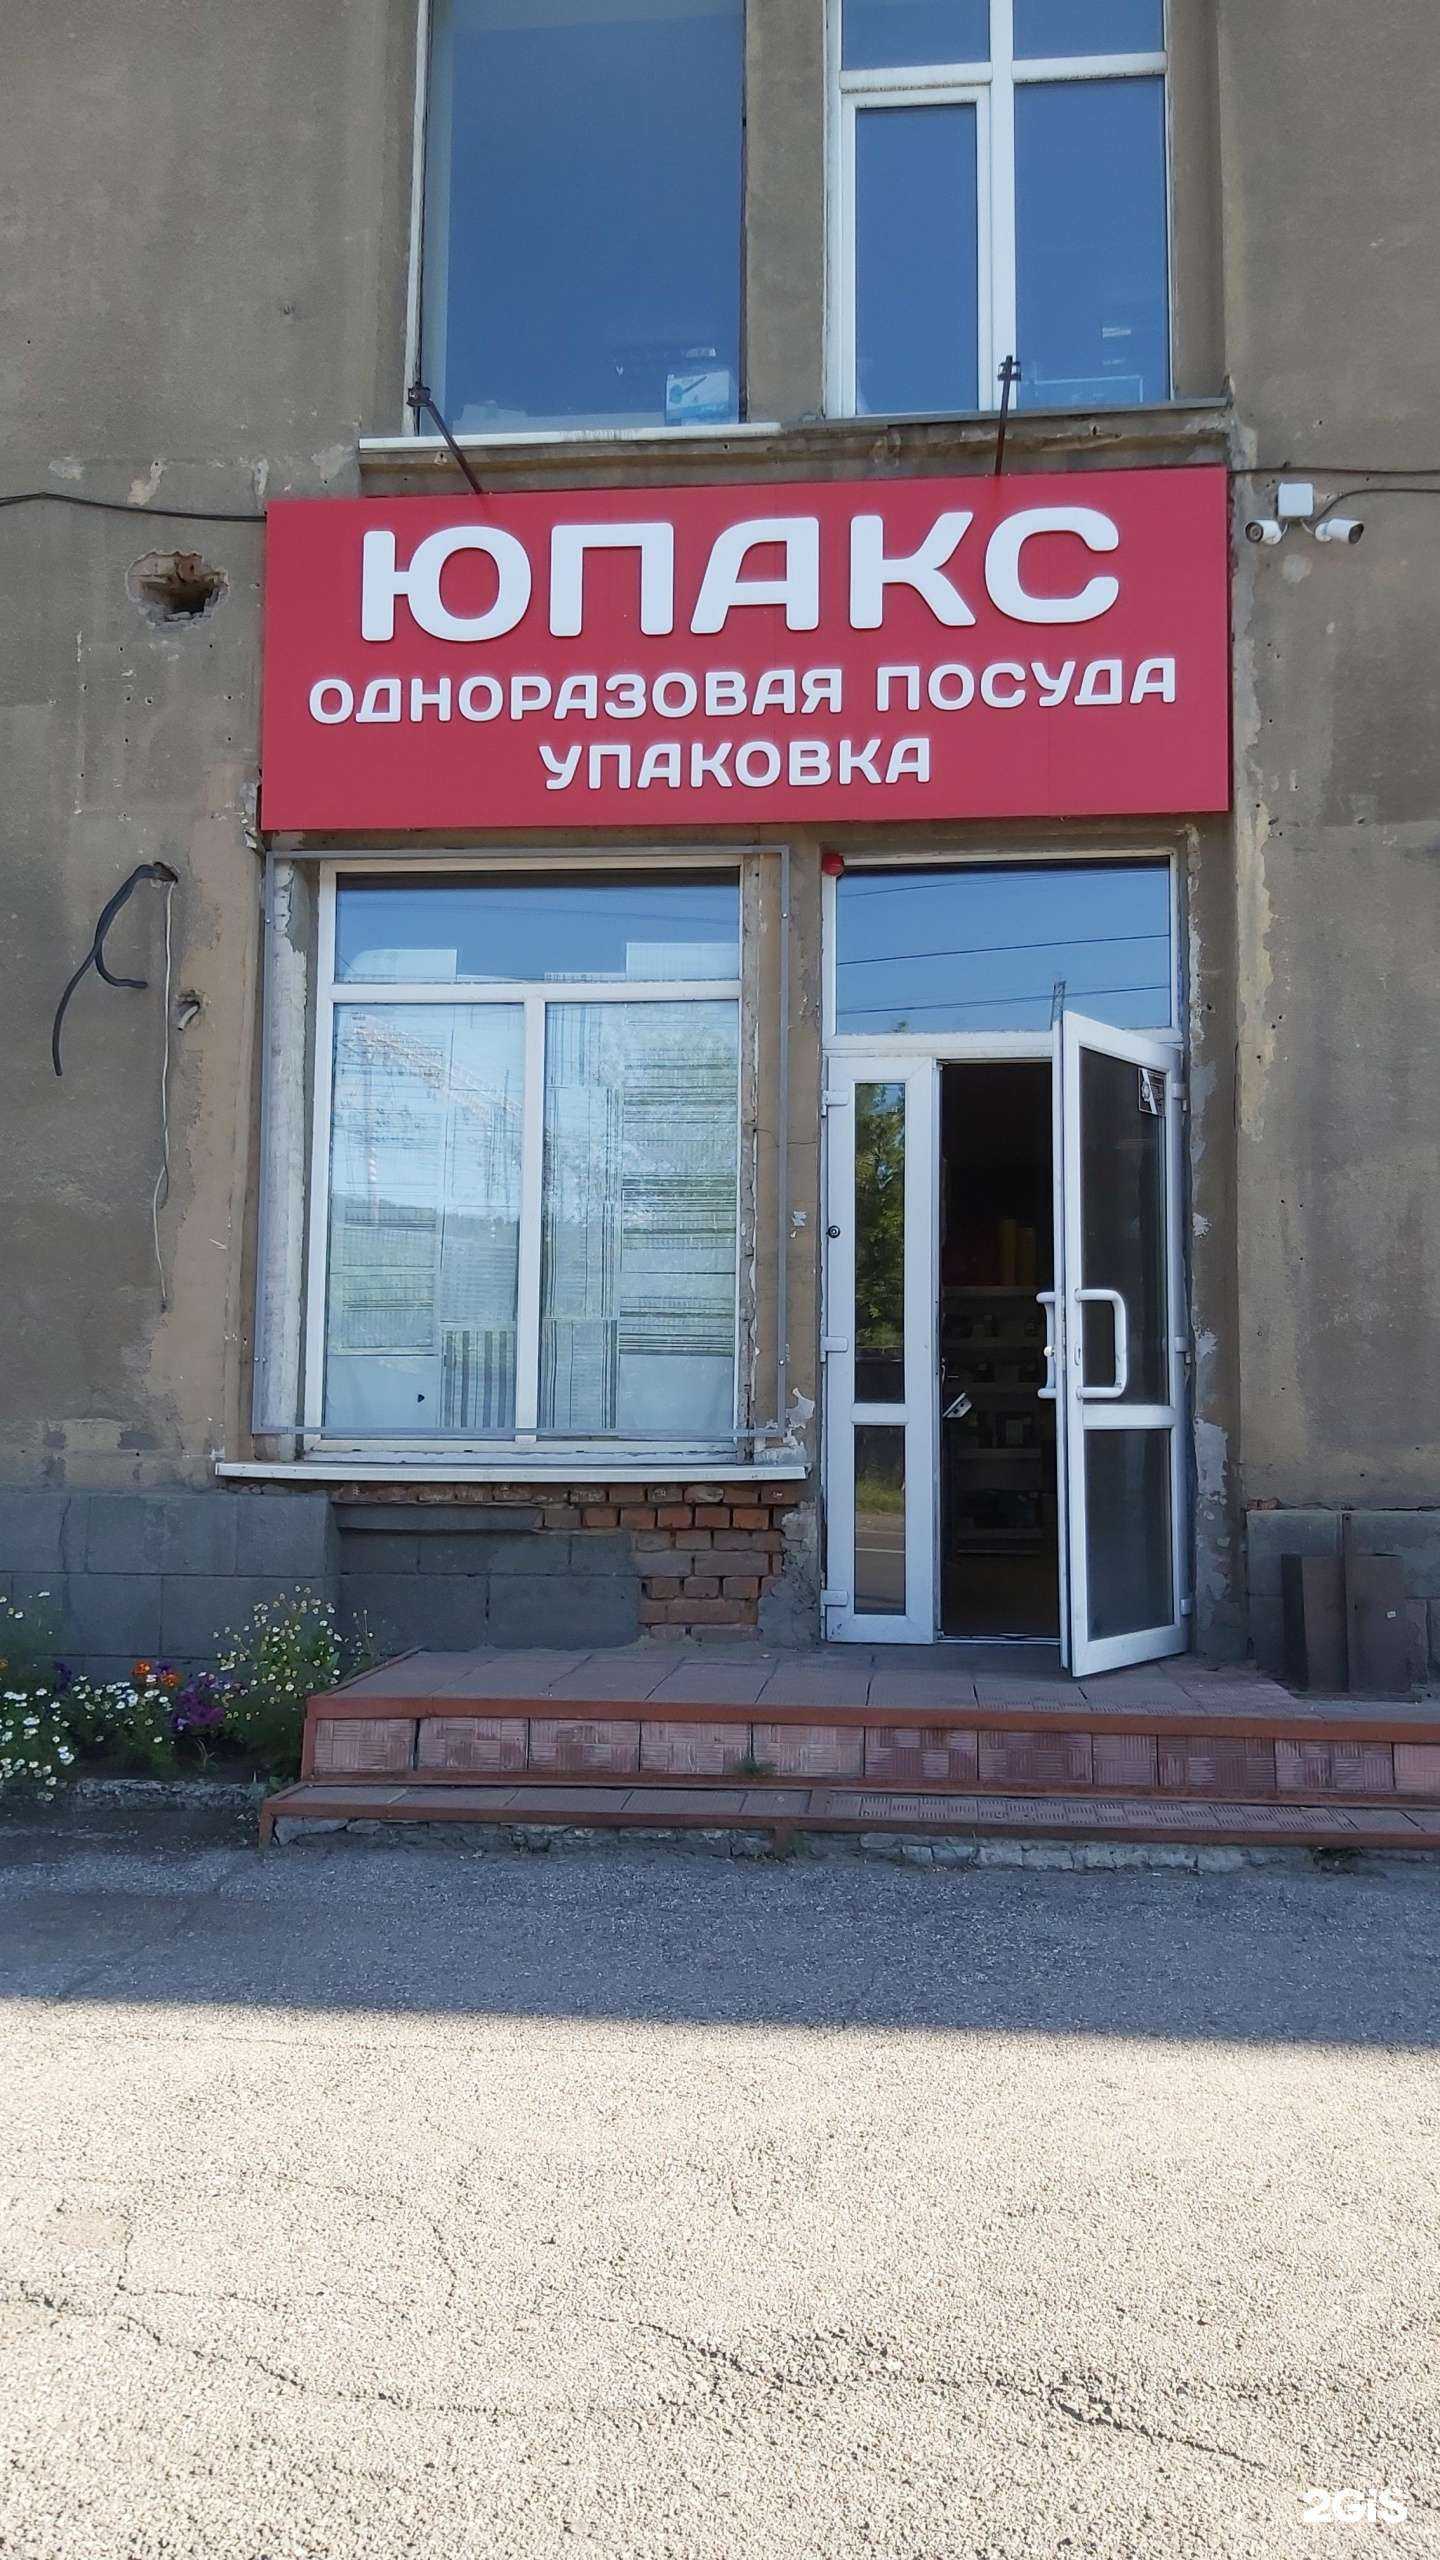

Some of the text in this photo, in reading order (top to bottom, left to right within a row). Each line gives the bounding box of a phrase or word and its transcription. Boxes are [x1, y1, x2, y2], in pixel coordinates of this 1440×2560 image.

[361, 506, 1120, 642] ЮПАКС
[309, 657, 1176, 724] ОДНОРАЗОВАЯ ПОСУДА
[539, 737, 930, 790] УПАКОВКА
